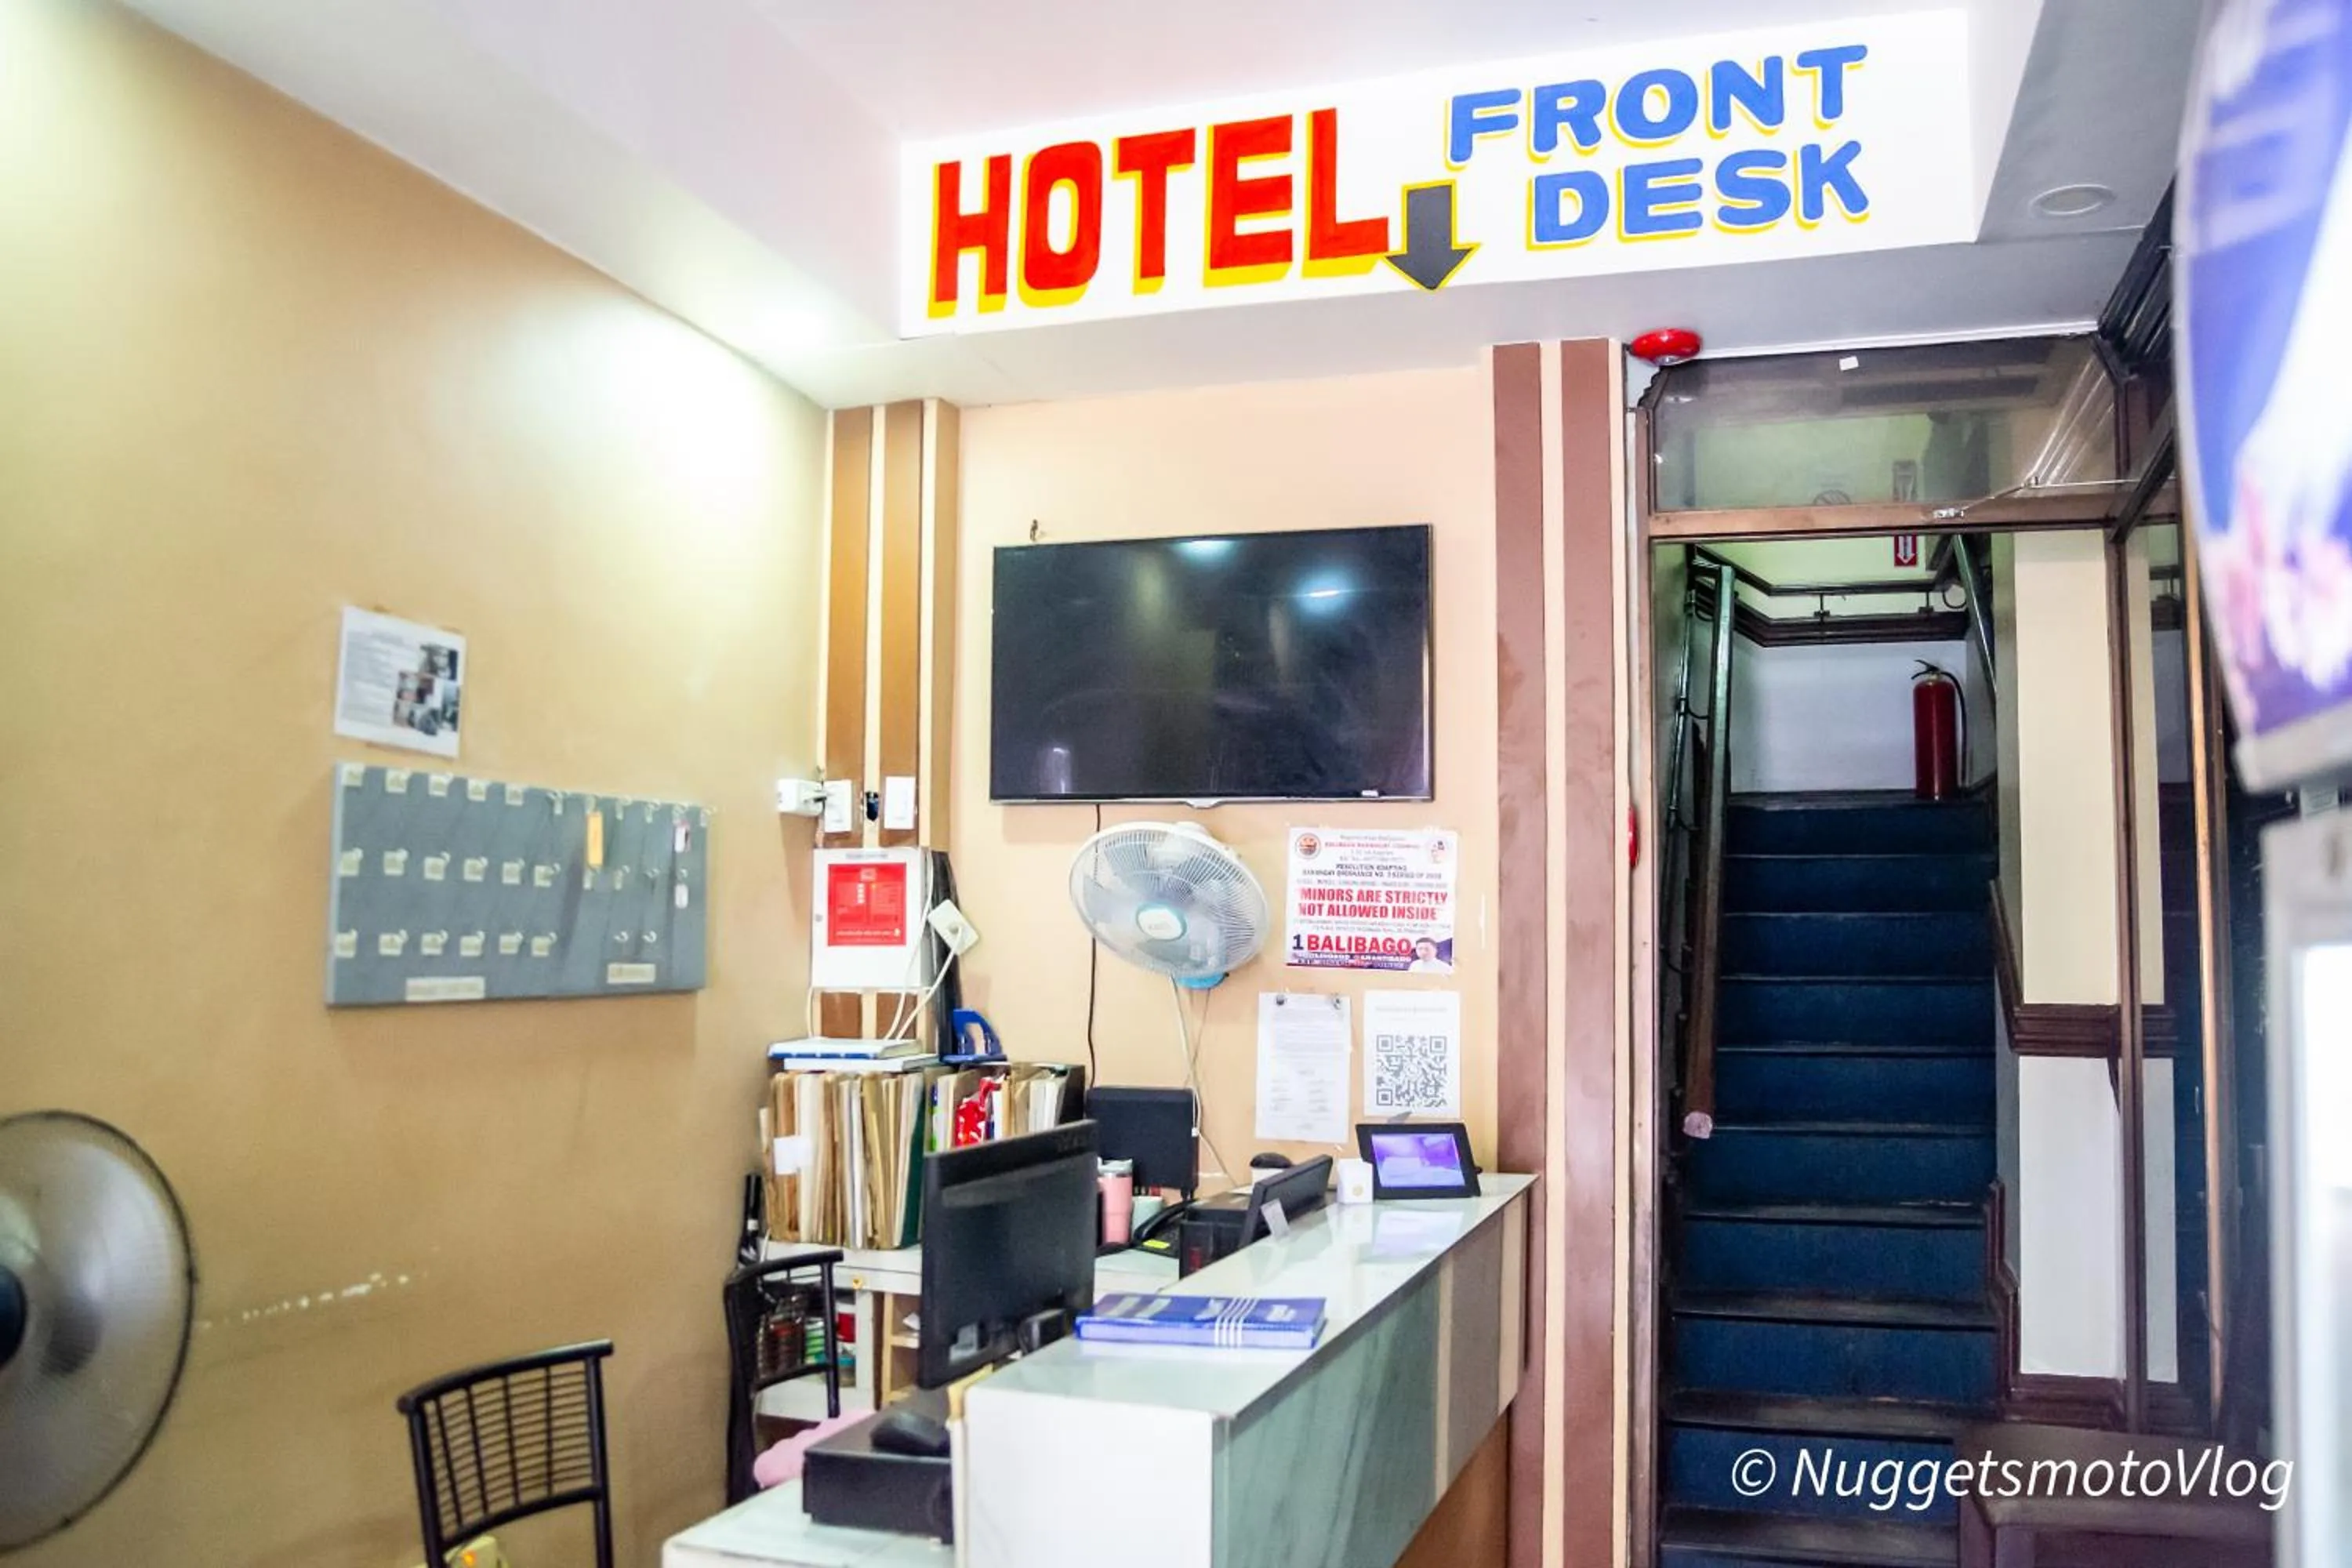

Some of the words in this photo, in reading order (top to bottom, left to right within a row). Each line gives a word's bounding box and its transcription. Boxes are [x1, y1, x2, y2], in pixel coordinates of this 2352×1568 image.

[1446, 44, 1869, 166] FRONT
[928, 108, 1390, 318] HOTEL
[1527, 140, 1870, 250] DESK
[1298, 902, 1323, 916] NOT
[1327, 903, 1388, 918] ALLOWED
[1356, 889, 1382, 902] ARE
[1385, 890, 1448, 905] STRICTLY
[1292, 934, 1304, 950] 1
[1307, 934, 1412, 955] BALIBAGO
